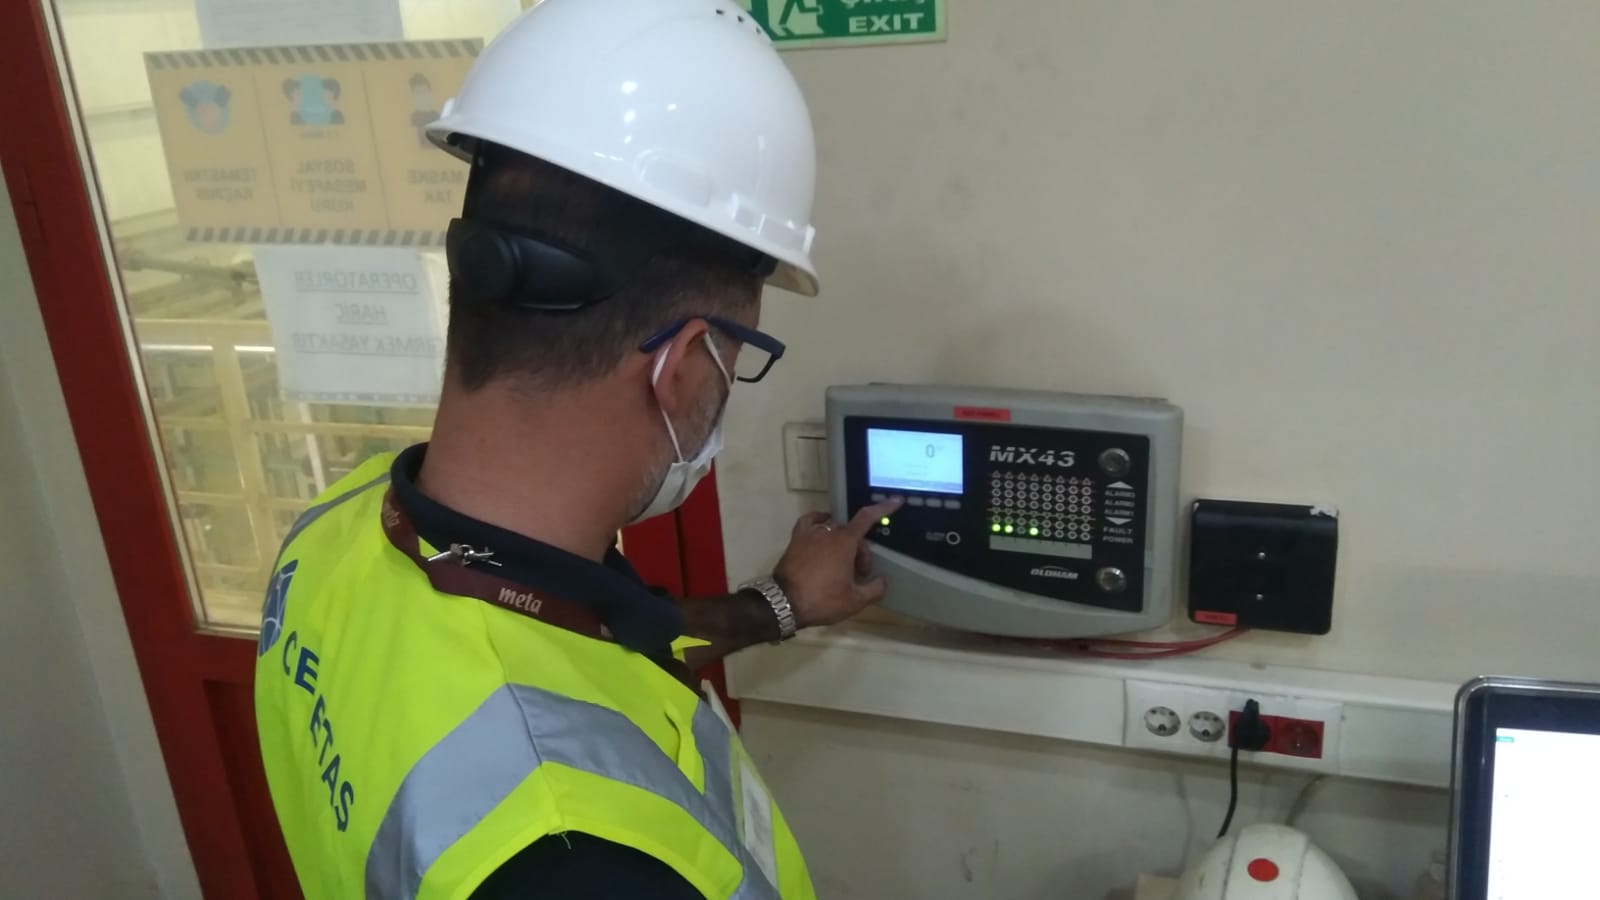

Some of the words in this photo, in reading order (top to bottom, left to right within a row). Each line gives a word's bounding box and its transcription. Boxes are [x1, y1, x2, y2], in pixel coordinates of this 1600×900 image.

[848, 13, 924, 33] EXIT
[926, 444, 935, 458] 0
[989, 445, 1075, 467] MX43
[499, 587, 542, 614] meta
